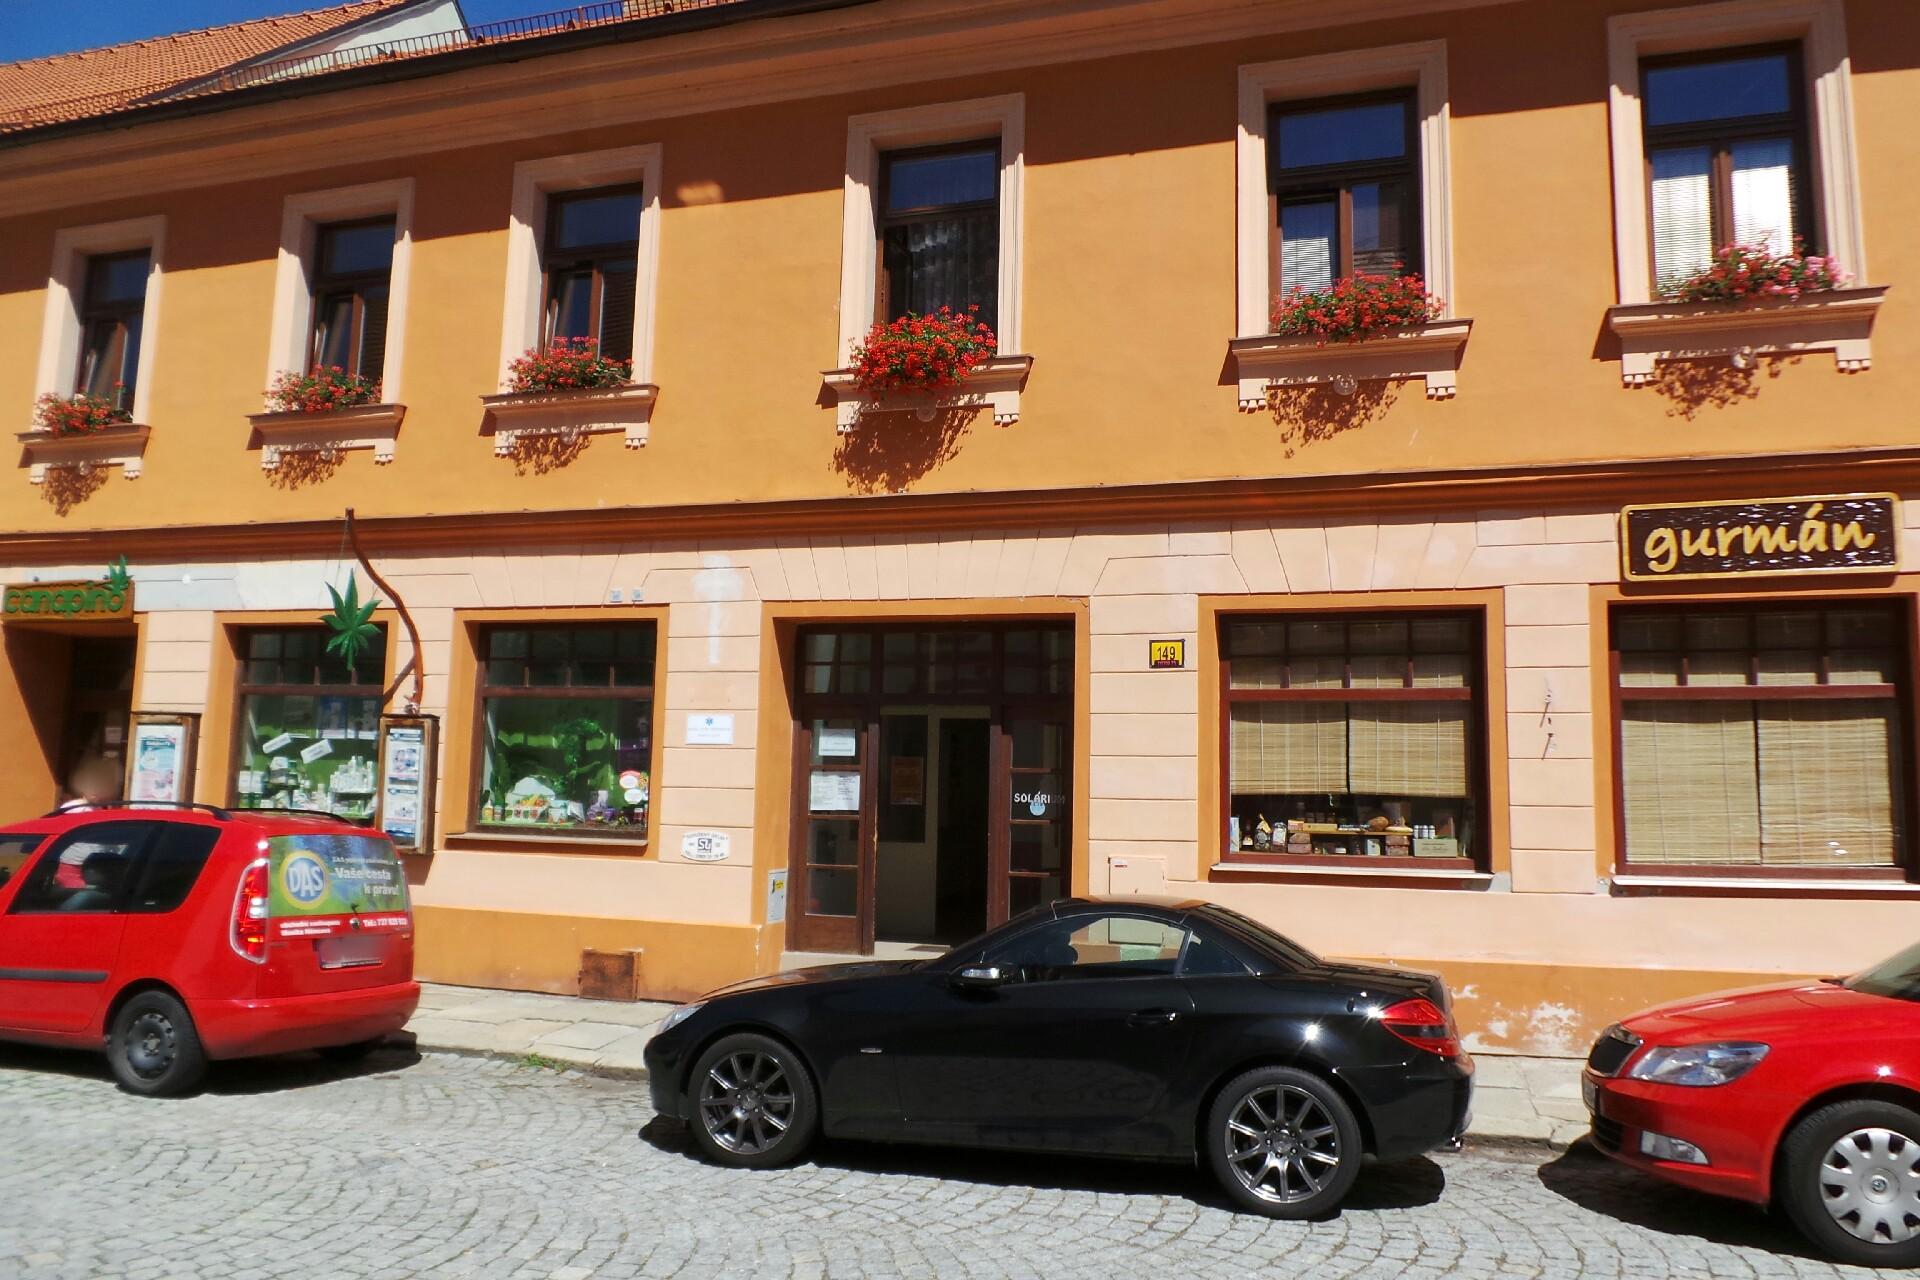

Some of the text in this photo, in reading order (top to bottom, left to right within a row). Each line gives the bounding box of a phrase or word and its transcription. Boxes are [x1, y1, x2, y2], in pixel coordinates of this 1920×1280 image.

[1644, 503, 1876, 573] gurmán
[4, 580, 126, 619] canapino
[1157, 646, 1176, 661] 149
[287, 862, 325, 897] DAS
